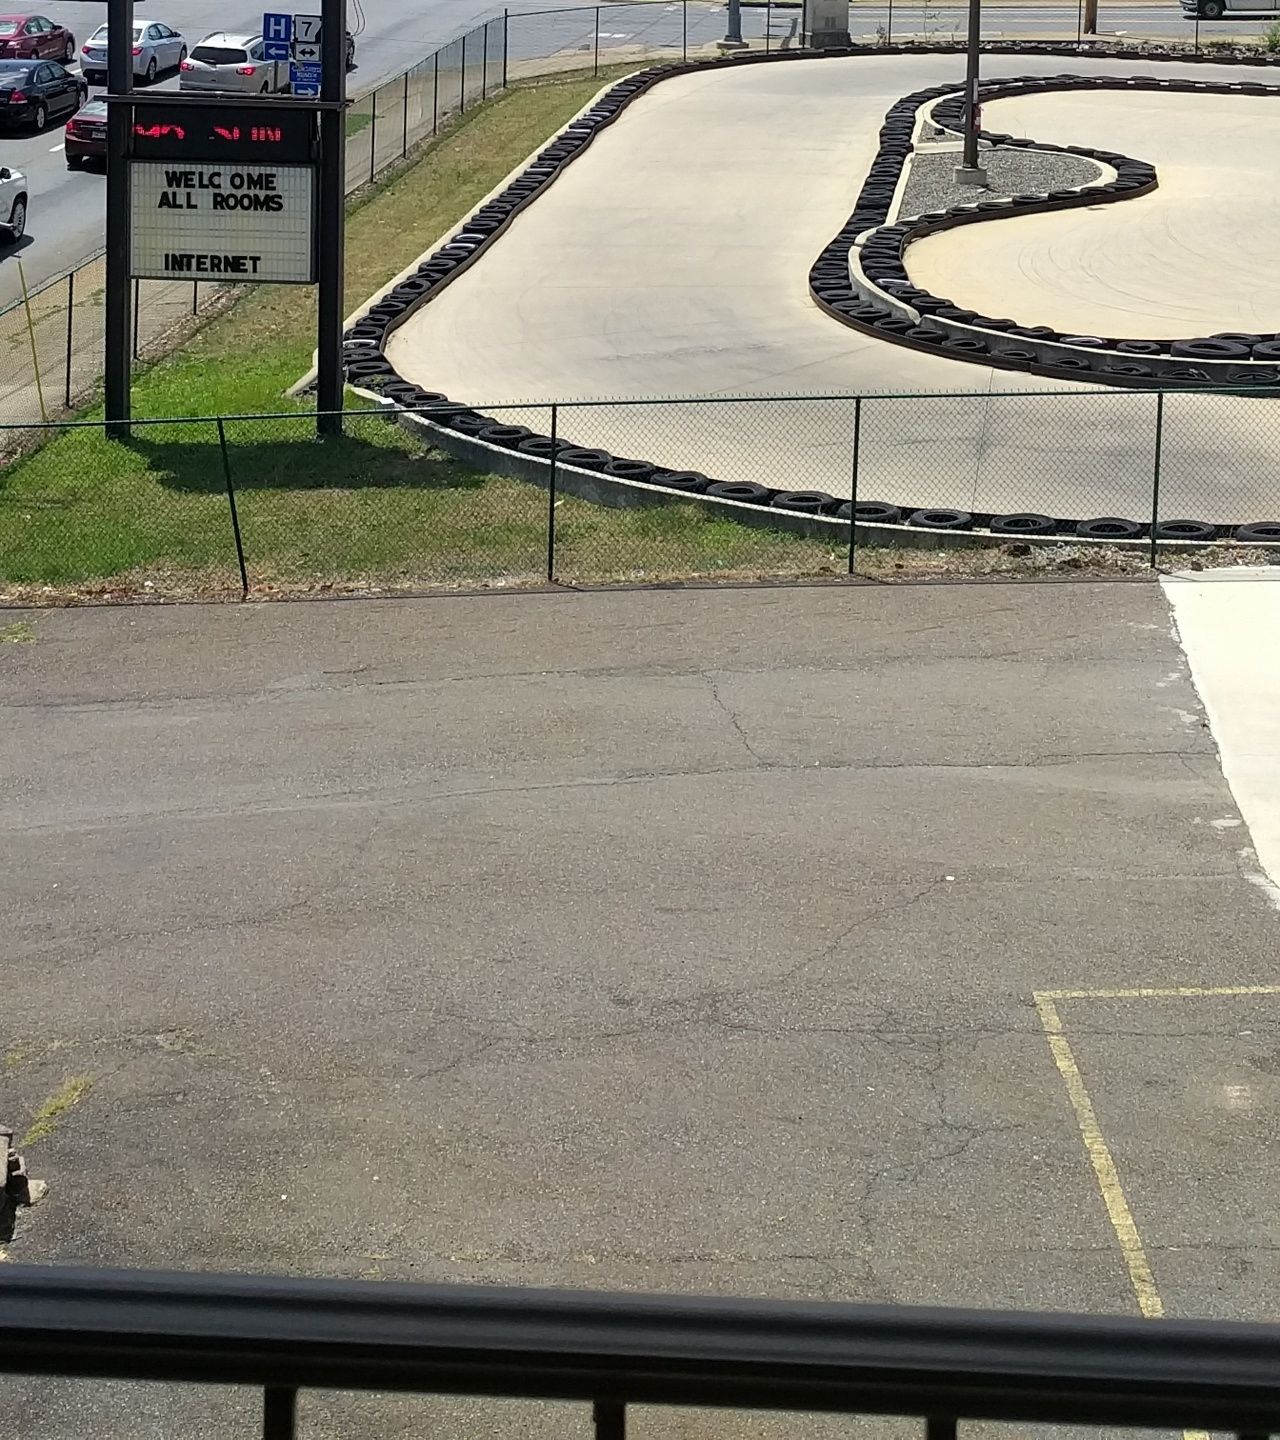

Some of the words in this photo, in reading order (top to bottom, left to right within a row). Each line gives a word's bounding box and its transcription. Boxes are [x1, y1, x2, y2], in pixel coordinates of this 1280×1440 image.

[269, 17, 286, 39] H
[301, 21, 313, 37] 7
[158, 191, 198, 209] ALL
[213, 193, 283, 211] ROOMS
[164, 253, 261, 273] INTERNET
